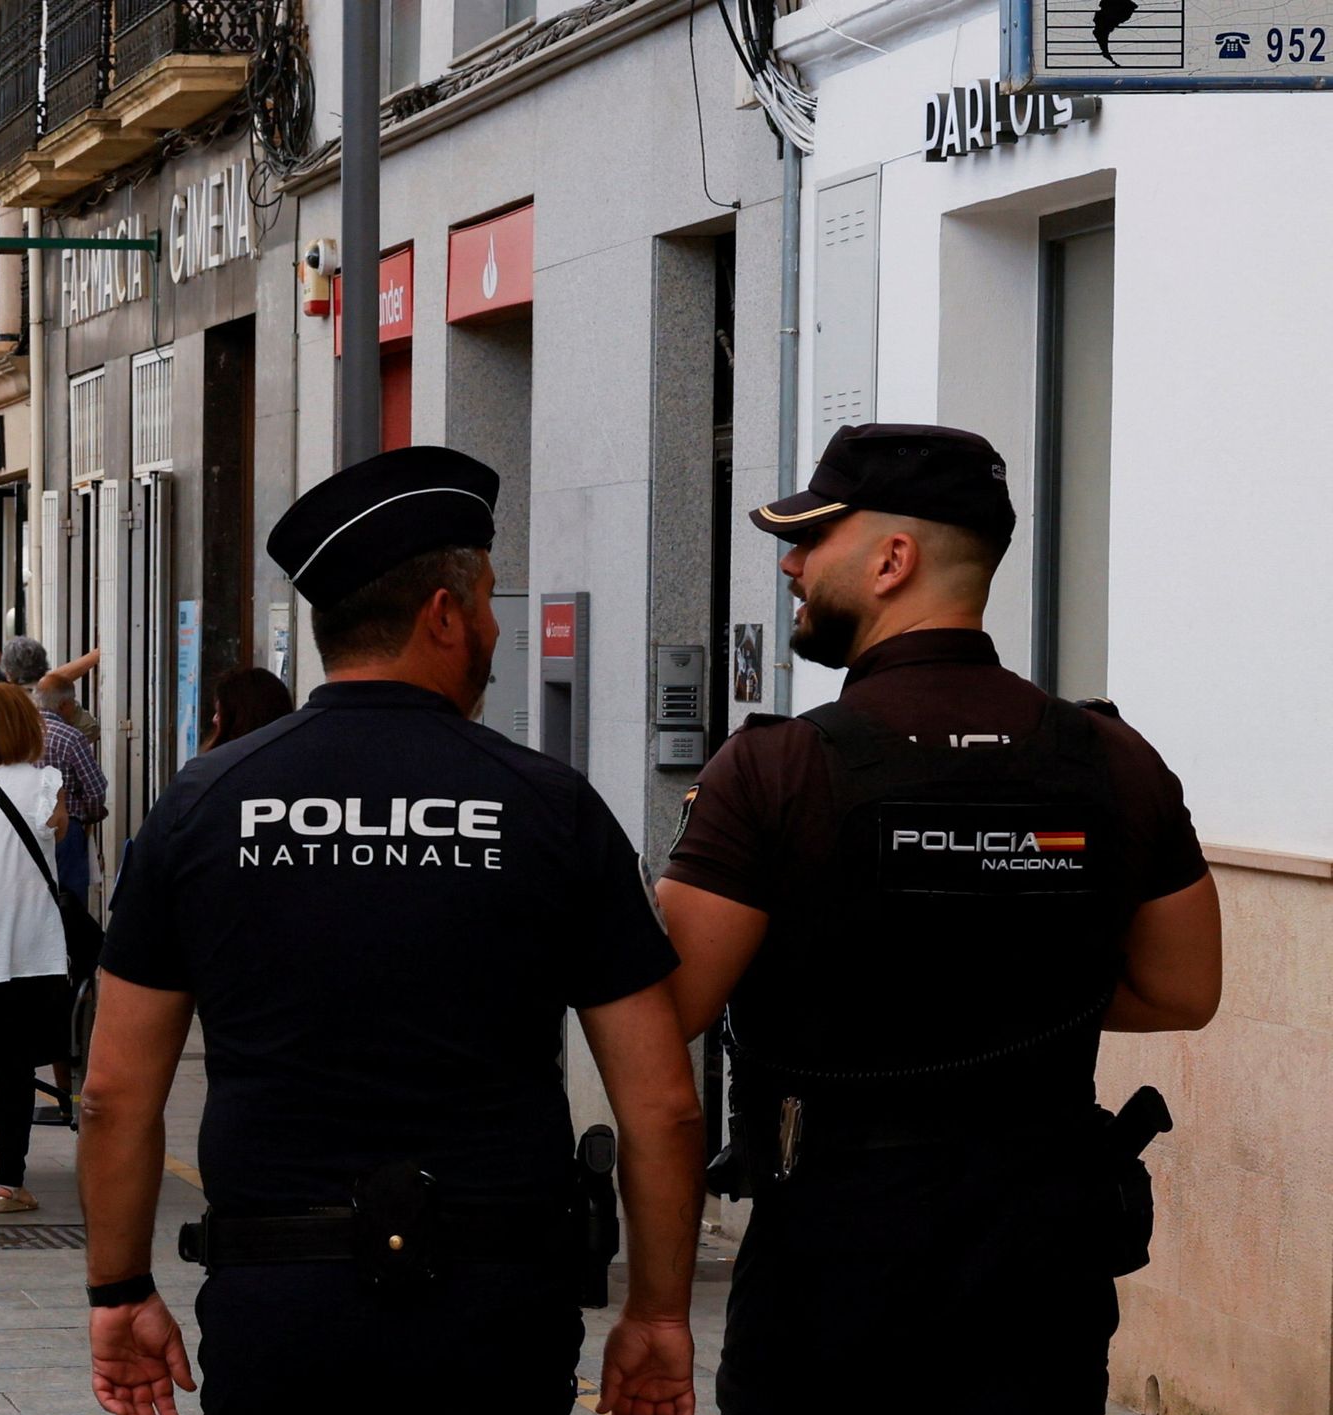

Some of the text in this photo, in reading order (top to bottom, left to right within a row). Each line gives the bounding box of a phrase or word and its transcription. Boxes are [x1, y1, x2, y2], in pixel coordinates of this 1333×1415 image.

[1266, 27, 1326, 64] 952
[61, 212, 142, 329] FARMACIA
[240, 797, 504, 840] POLICE
[239, 843, 503, 870] NATIONALE
[981, 857, 1083, 870] NACIONAL
